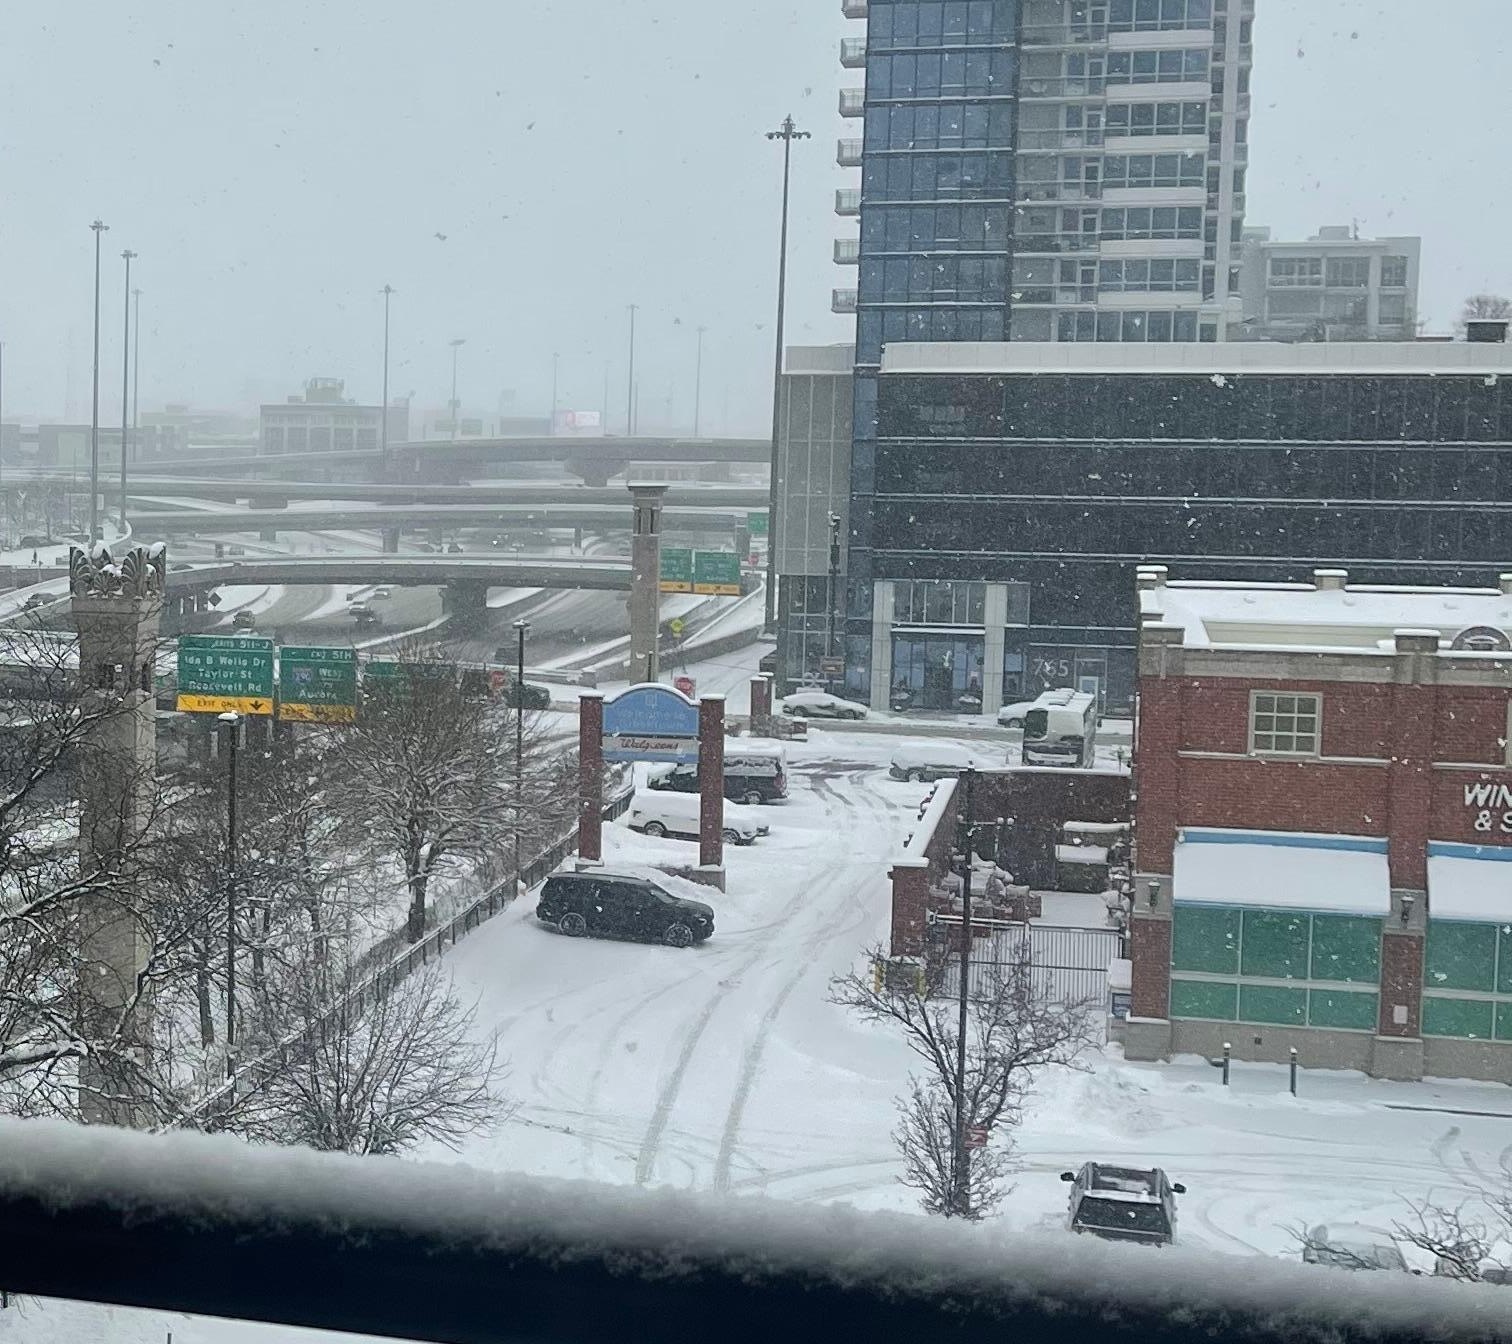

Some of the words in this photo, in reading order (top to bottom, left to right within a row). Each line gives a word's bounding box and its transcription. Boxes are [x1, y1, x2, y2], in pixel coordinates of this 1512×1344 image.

[206, 656, 213, 665] B
[219, 656, 248, 666] Wells
[253, 657, 266, 667] Dr
[1032, 658, 1069, 677] 765
[198, 668, 234, 680] Taylor
[240, 670, 252, 679] St
[248, 683, 262, 692] Rd
[1474, 809, 1492, 831] &
